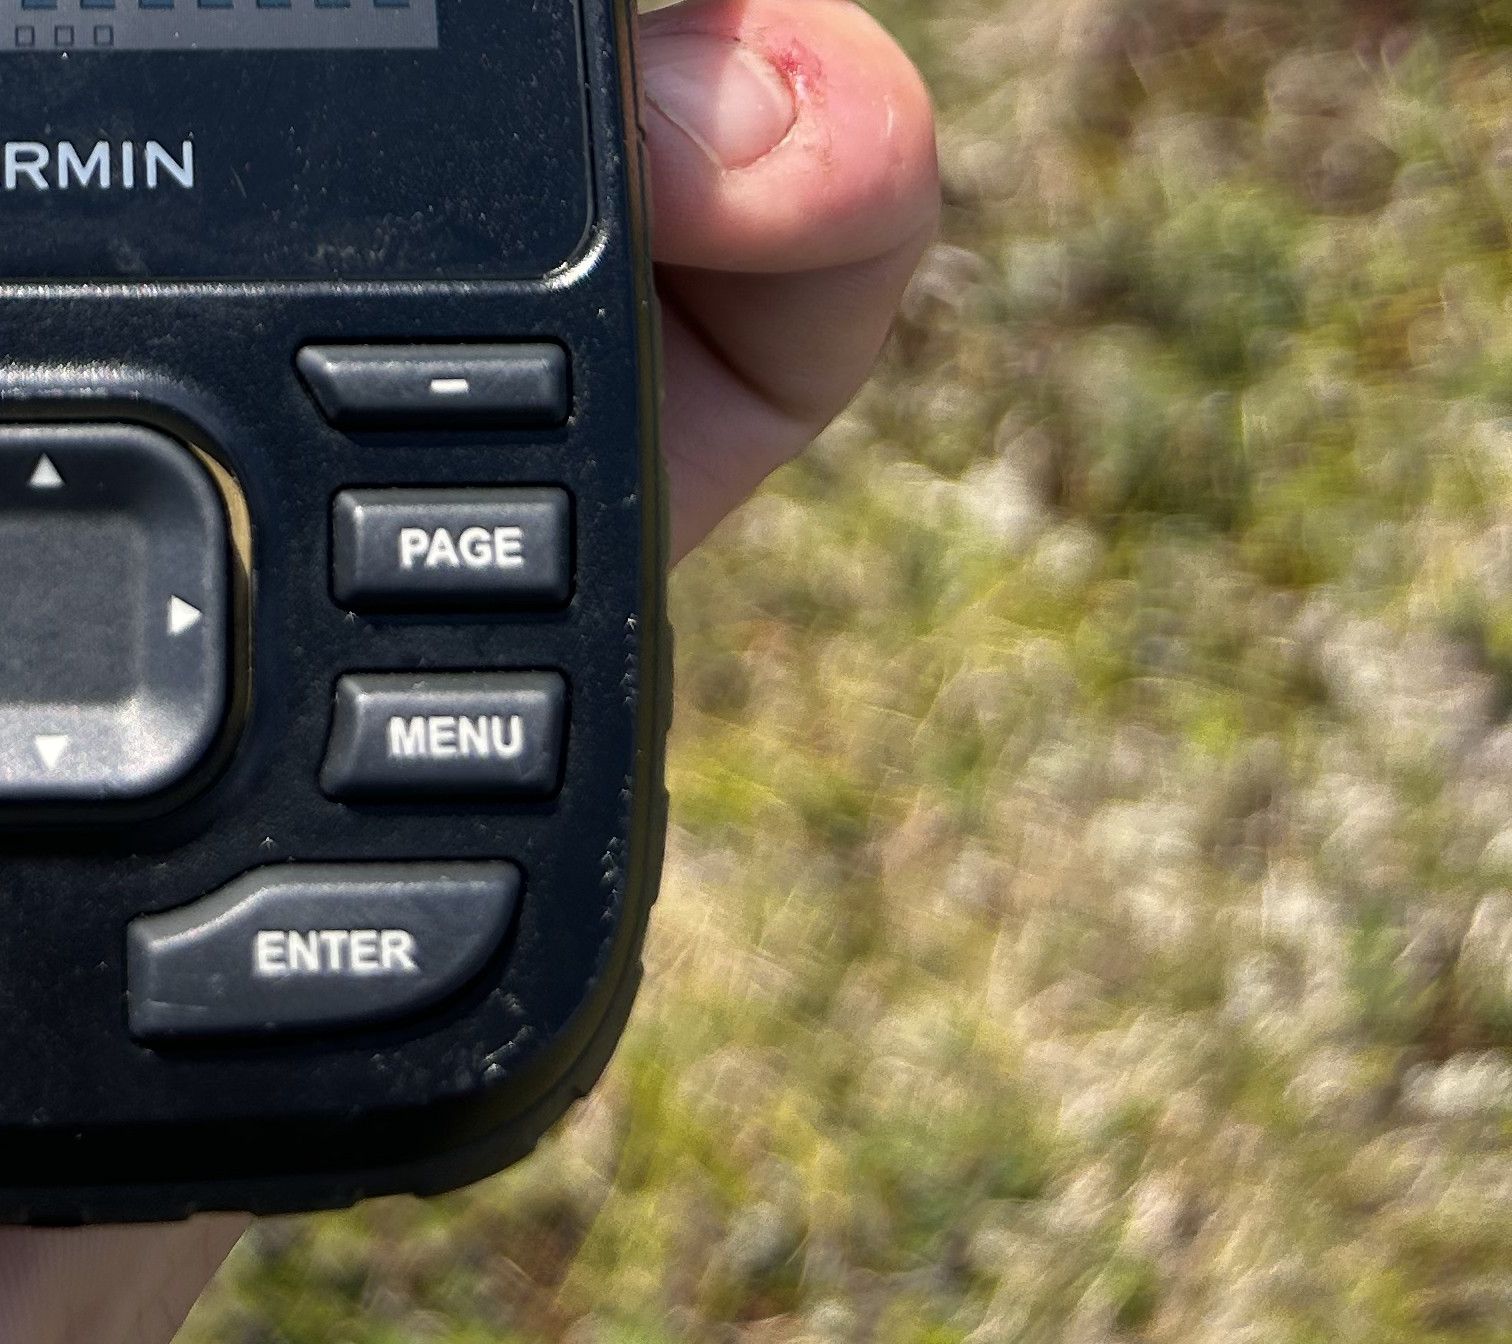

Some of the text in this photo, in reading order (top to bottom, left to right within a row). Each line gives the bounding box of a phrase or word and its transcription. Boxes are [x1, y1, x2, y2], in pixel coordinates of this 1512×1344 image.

[399, 526, 524, 569] PAGE
[388, 715, 524, 759] MENU
[253, 930, 416, 975] ENTER
